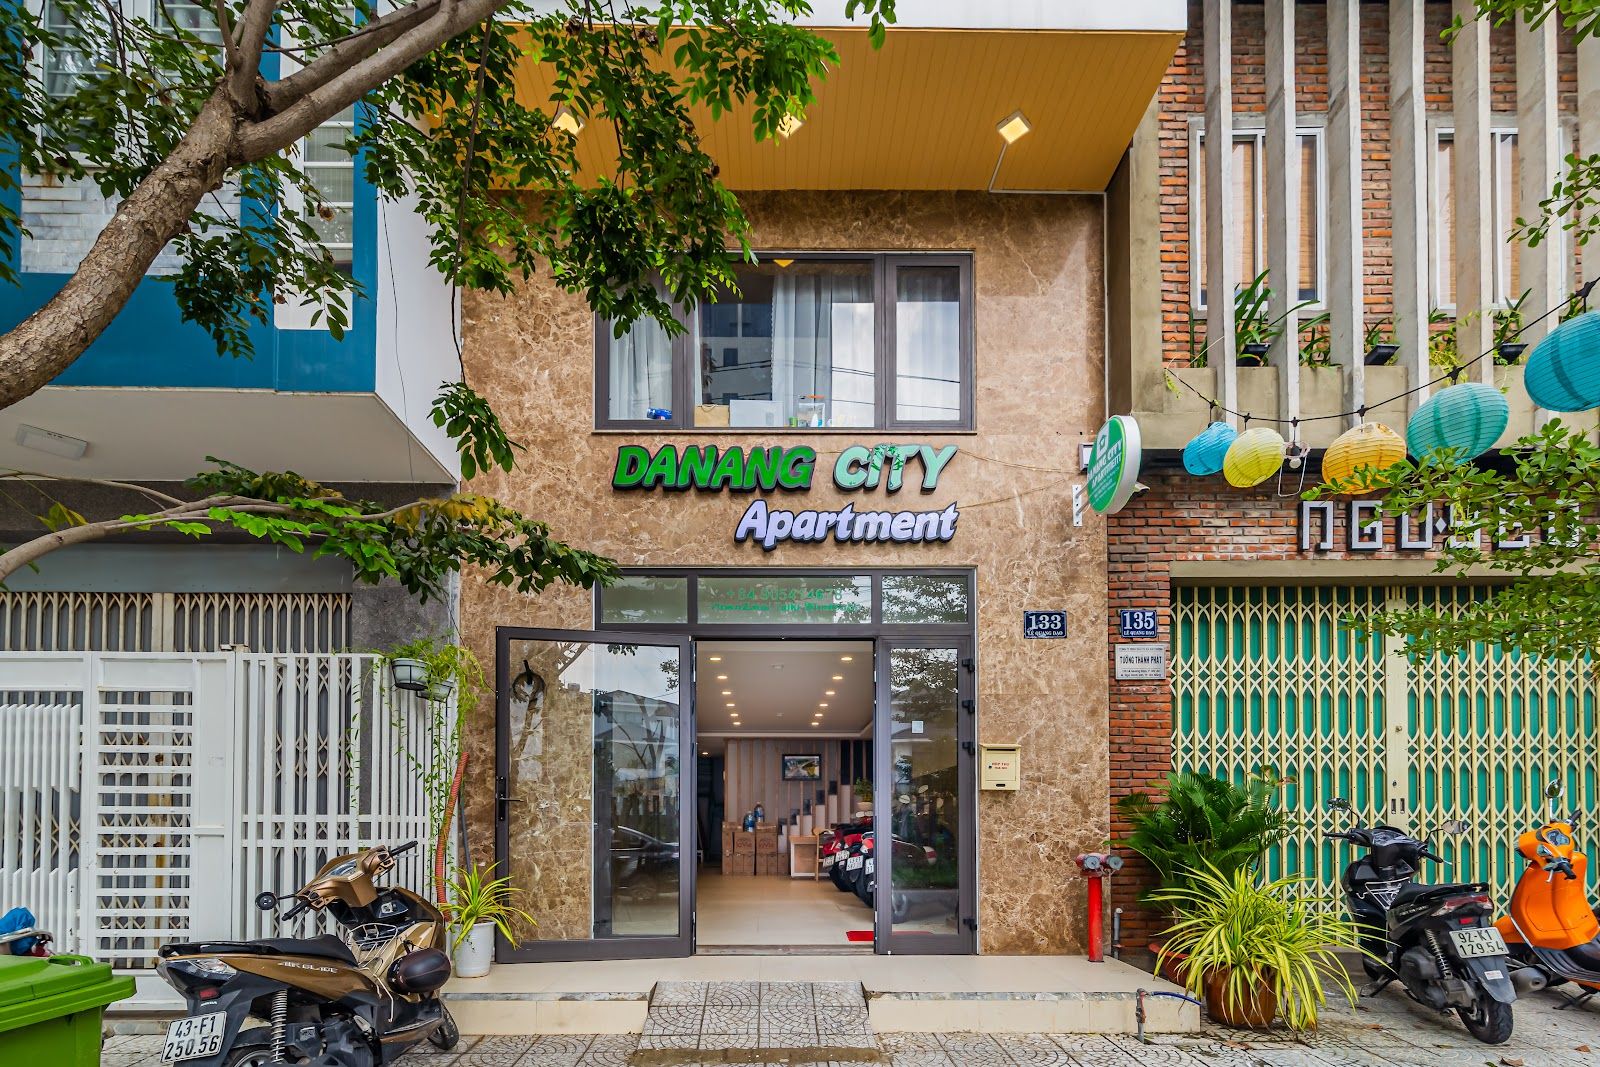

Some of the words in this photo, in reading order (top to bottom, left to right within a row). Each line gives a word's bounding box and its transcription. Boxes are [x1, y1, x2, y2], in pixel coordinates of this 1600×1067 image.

[613, 444, 816, 491] DANANG
[832, 443, 958, 492] CITY
[735, 499, 960, 551] Apartment
[1029, 614, 1062, 630] 133
[1123, 611, 1155, 630] 135
[1458, 930, 1493, 943] 92-K1
[175, 1014, 216, 1037] 43-F1
[164, 1034, 220, 1060] 250.56
